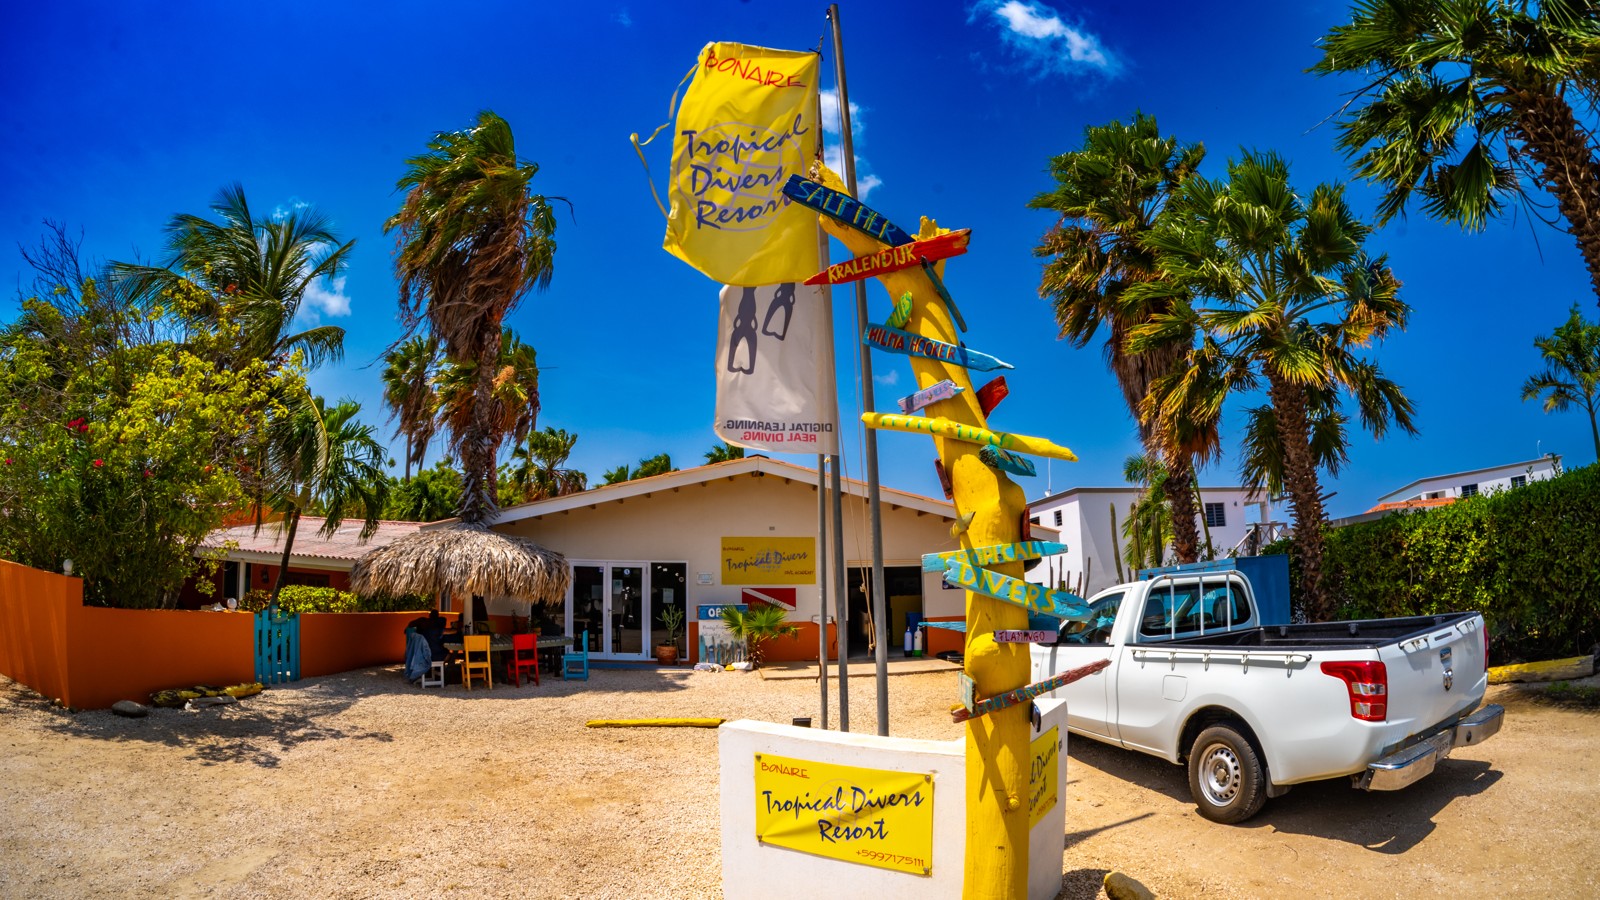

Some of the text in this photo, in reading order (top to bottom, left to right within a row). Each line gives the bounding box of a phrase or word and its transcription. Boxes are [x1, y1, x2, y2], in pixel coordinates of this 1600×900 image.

[705, 50, 807, 88] BONAIRE
[682, 113, 809, 164] Tropical
[690, 165, 787, 196] Divers
[793, 180, 897, 243] SALT PIER
[827, 244, 917, 283] KRALENDIJK
[867, 327, 957, 360] HILMA HOOKER
[726, 550, 808, 572] Tropical Divers
[938, 541, 1042, 569] TROPICAL
[958, 563, 1057, 612] DIVERS
[998, 631, 1045, 642] FLAMINGO
[968, 692, 1012, 717] HORE
[761, 762, 810, 779] BONAIRE
[762, 786, 925, 820] Tropical Divers
[818, 818, 889, 843] Resort
[856, 849, 925, 867] +5997175111
